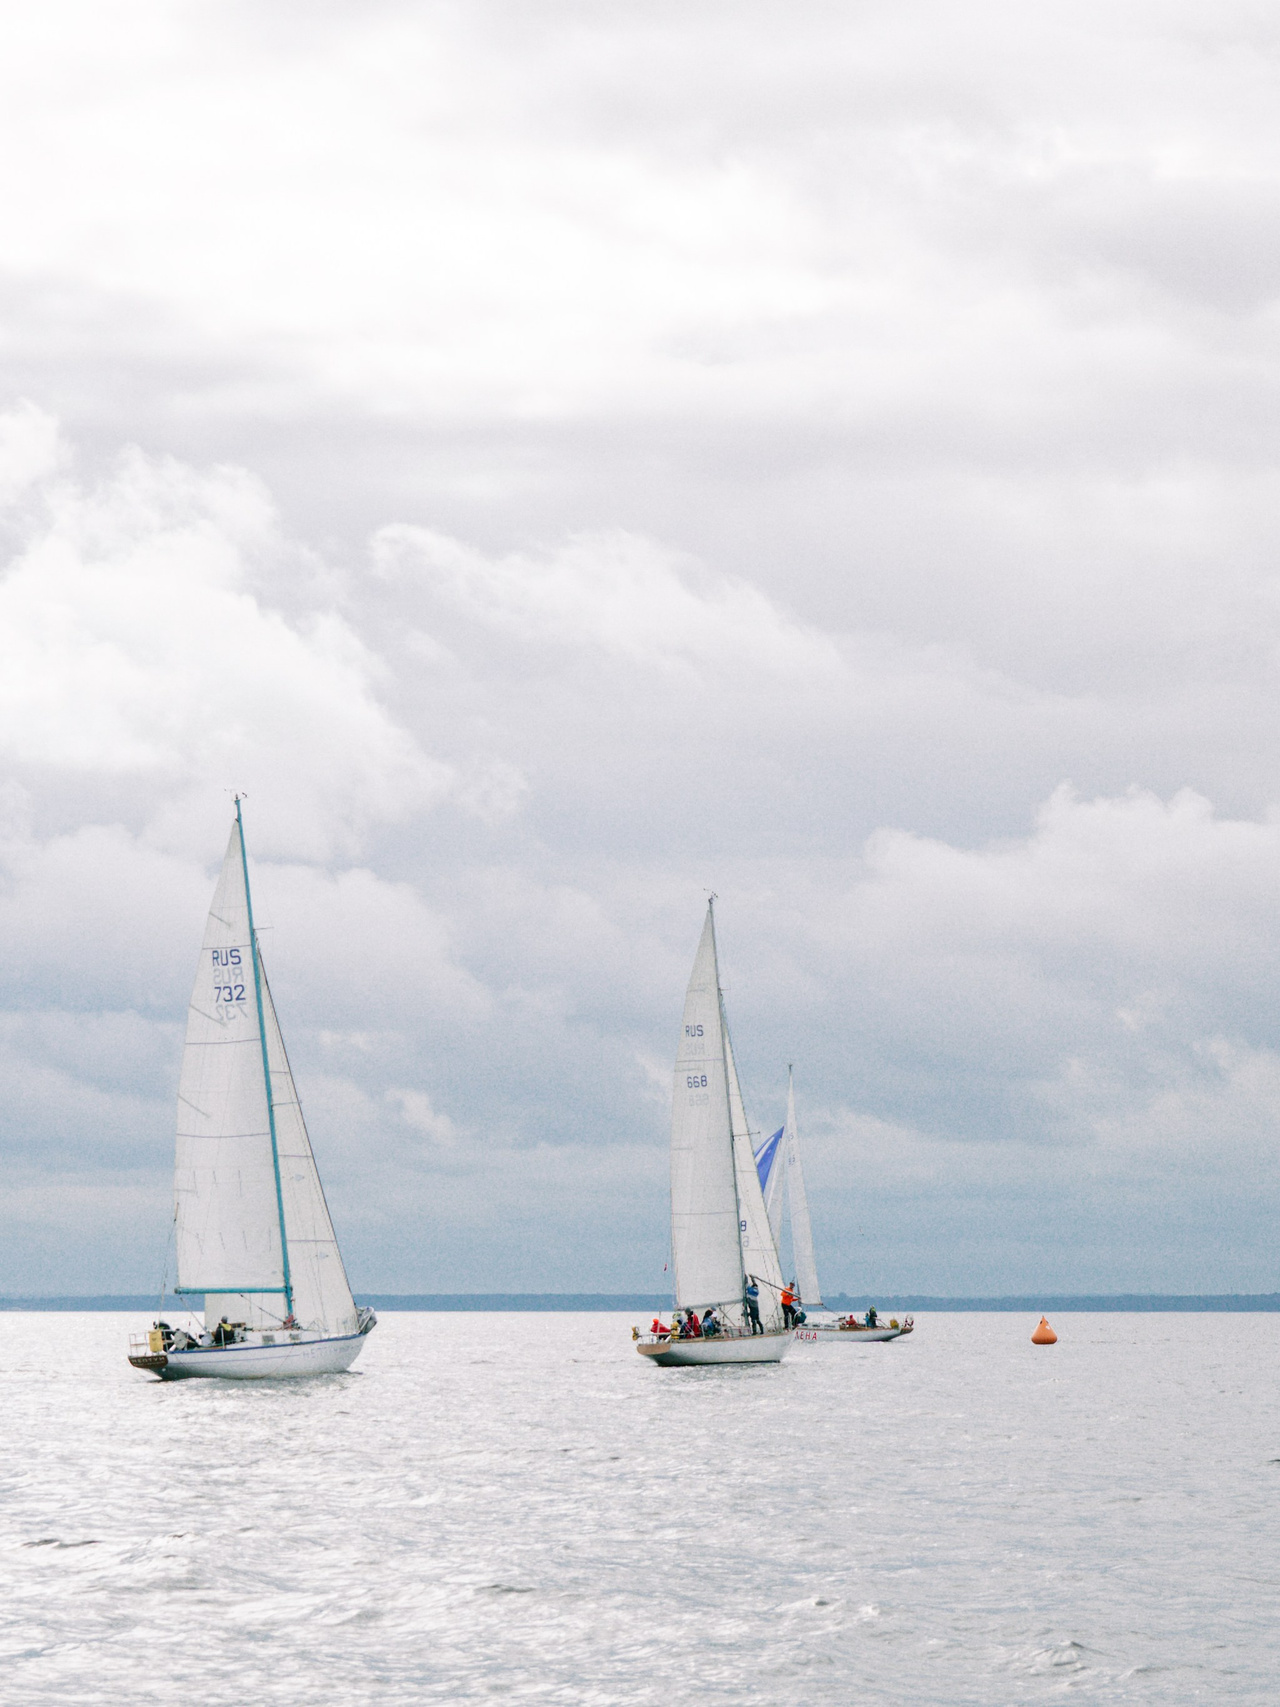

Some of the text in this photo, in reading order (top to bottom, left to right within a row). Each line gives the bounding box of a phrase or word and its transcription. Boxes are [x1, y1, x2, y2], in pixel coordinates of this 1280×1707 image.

[212, 948, 242, 967] RUS
[214, 984, 246, 1003] 732
[685, 1024, 704, 1038] RUS
[686, 1075, 708, 1089] 668
